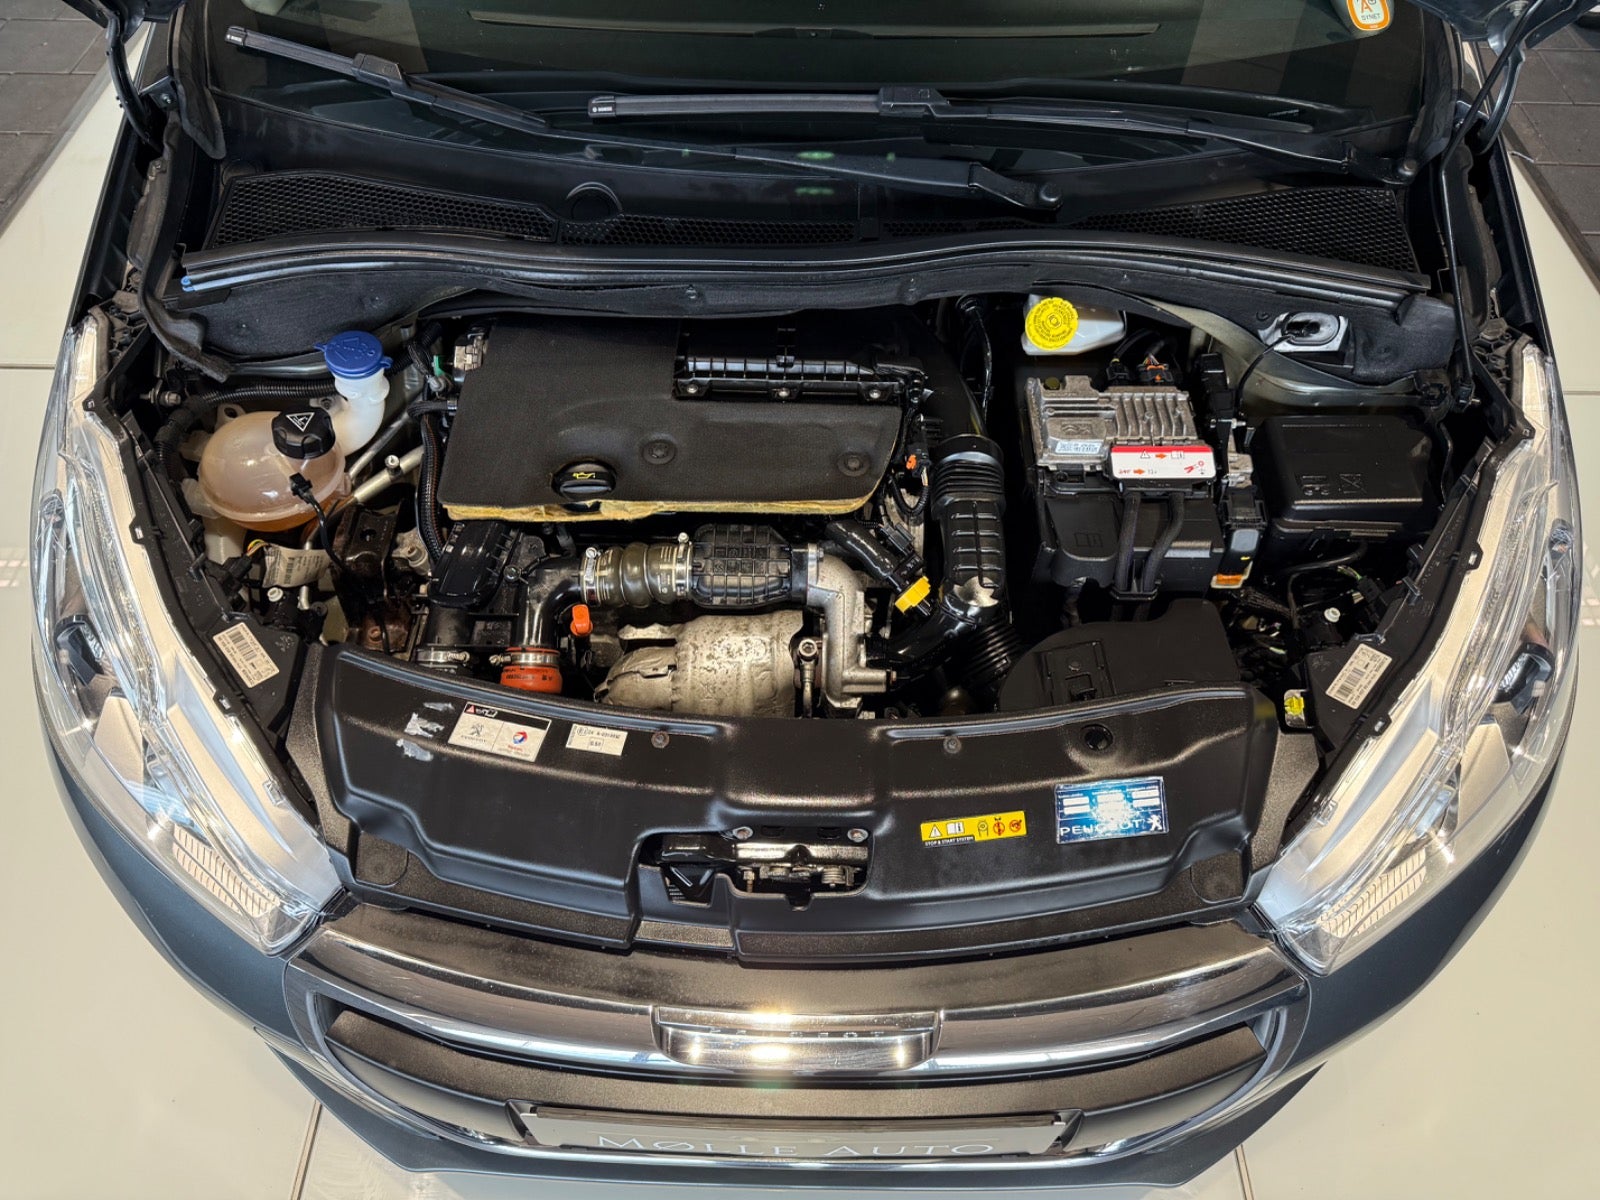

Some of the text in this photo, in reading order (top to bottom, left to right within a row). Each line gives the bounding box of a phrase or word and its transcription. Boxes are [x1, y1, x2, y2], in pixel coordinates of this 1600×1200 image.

[1060, 819, 1142, 836] PEUGOT
[924, 840, 938, 848] STOP
[598, 1135, 994, 1156] MØLLE AUTO
